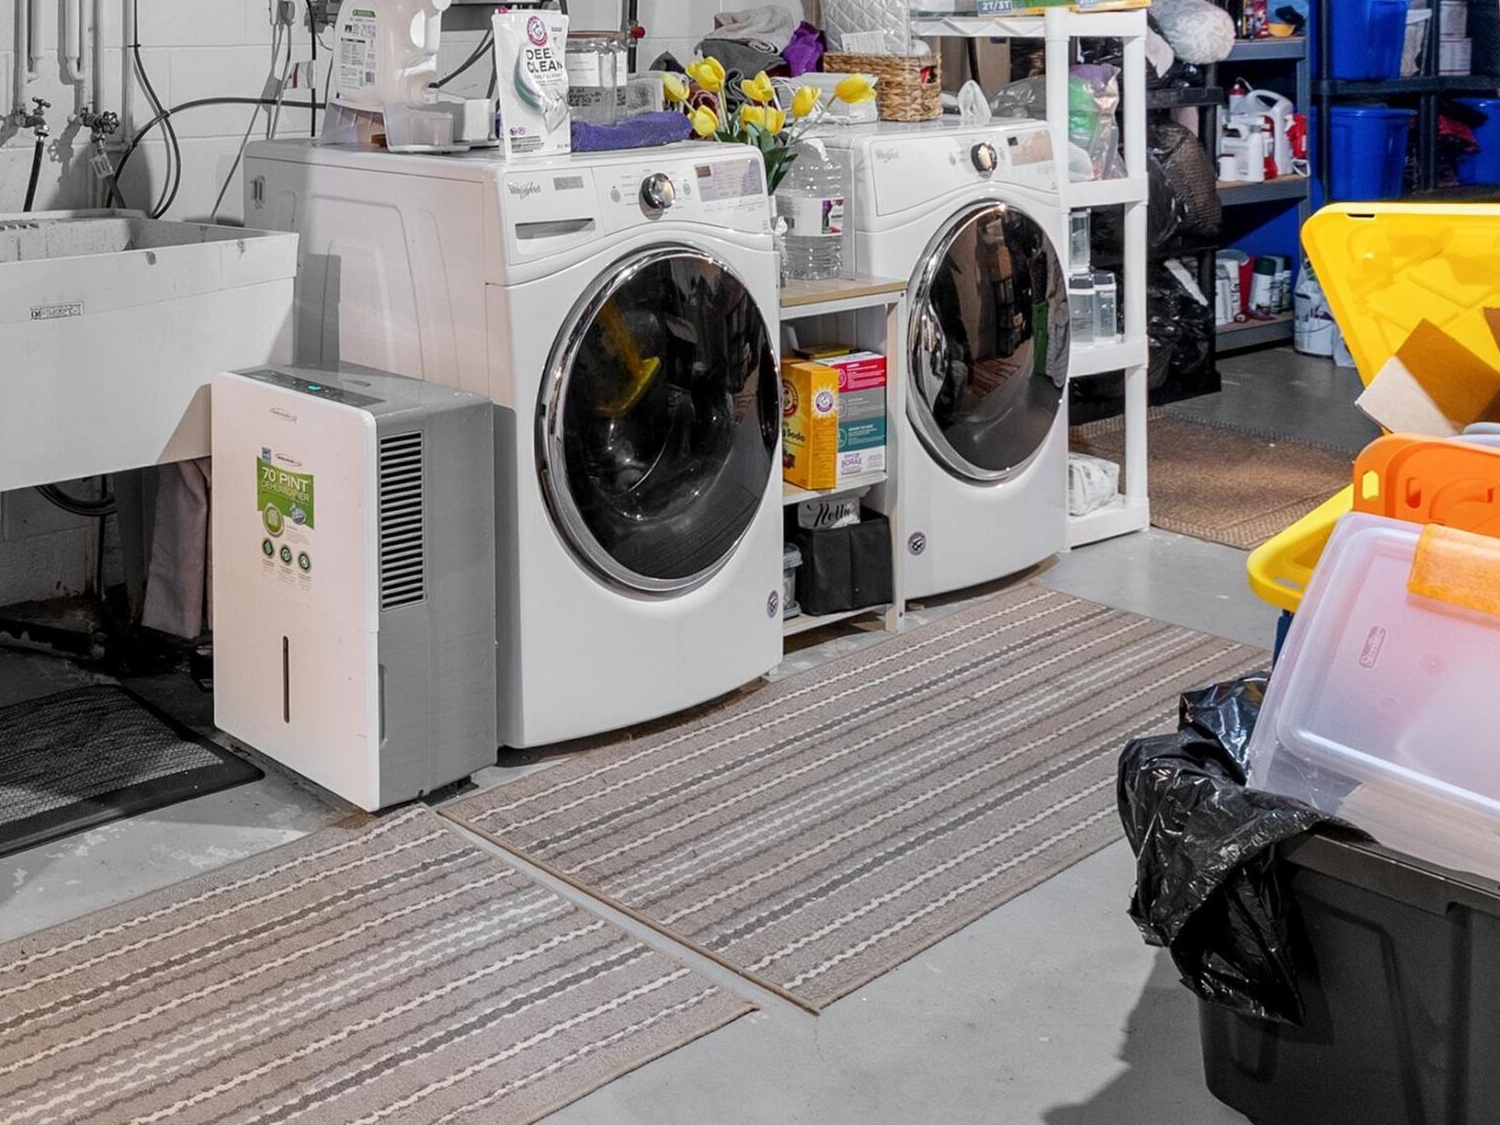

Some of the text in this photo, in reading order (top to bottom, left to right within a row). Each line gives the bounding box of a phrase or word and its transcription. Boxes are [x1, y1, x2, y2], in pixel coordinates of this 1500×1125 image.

[526, 47, 552, 60] DEE
[527, 60, 563, 73] CLEAN
[261, 466, 309, 493] 70 PINT
